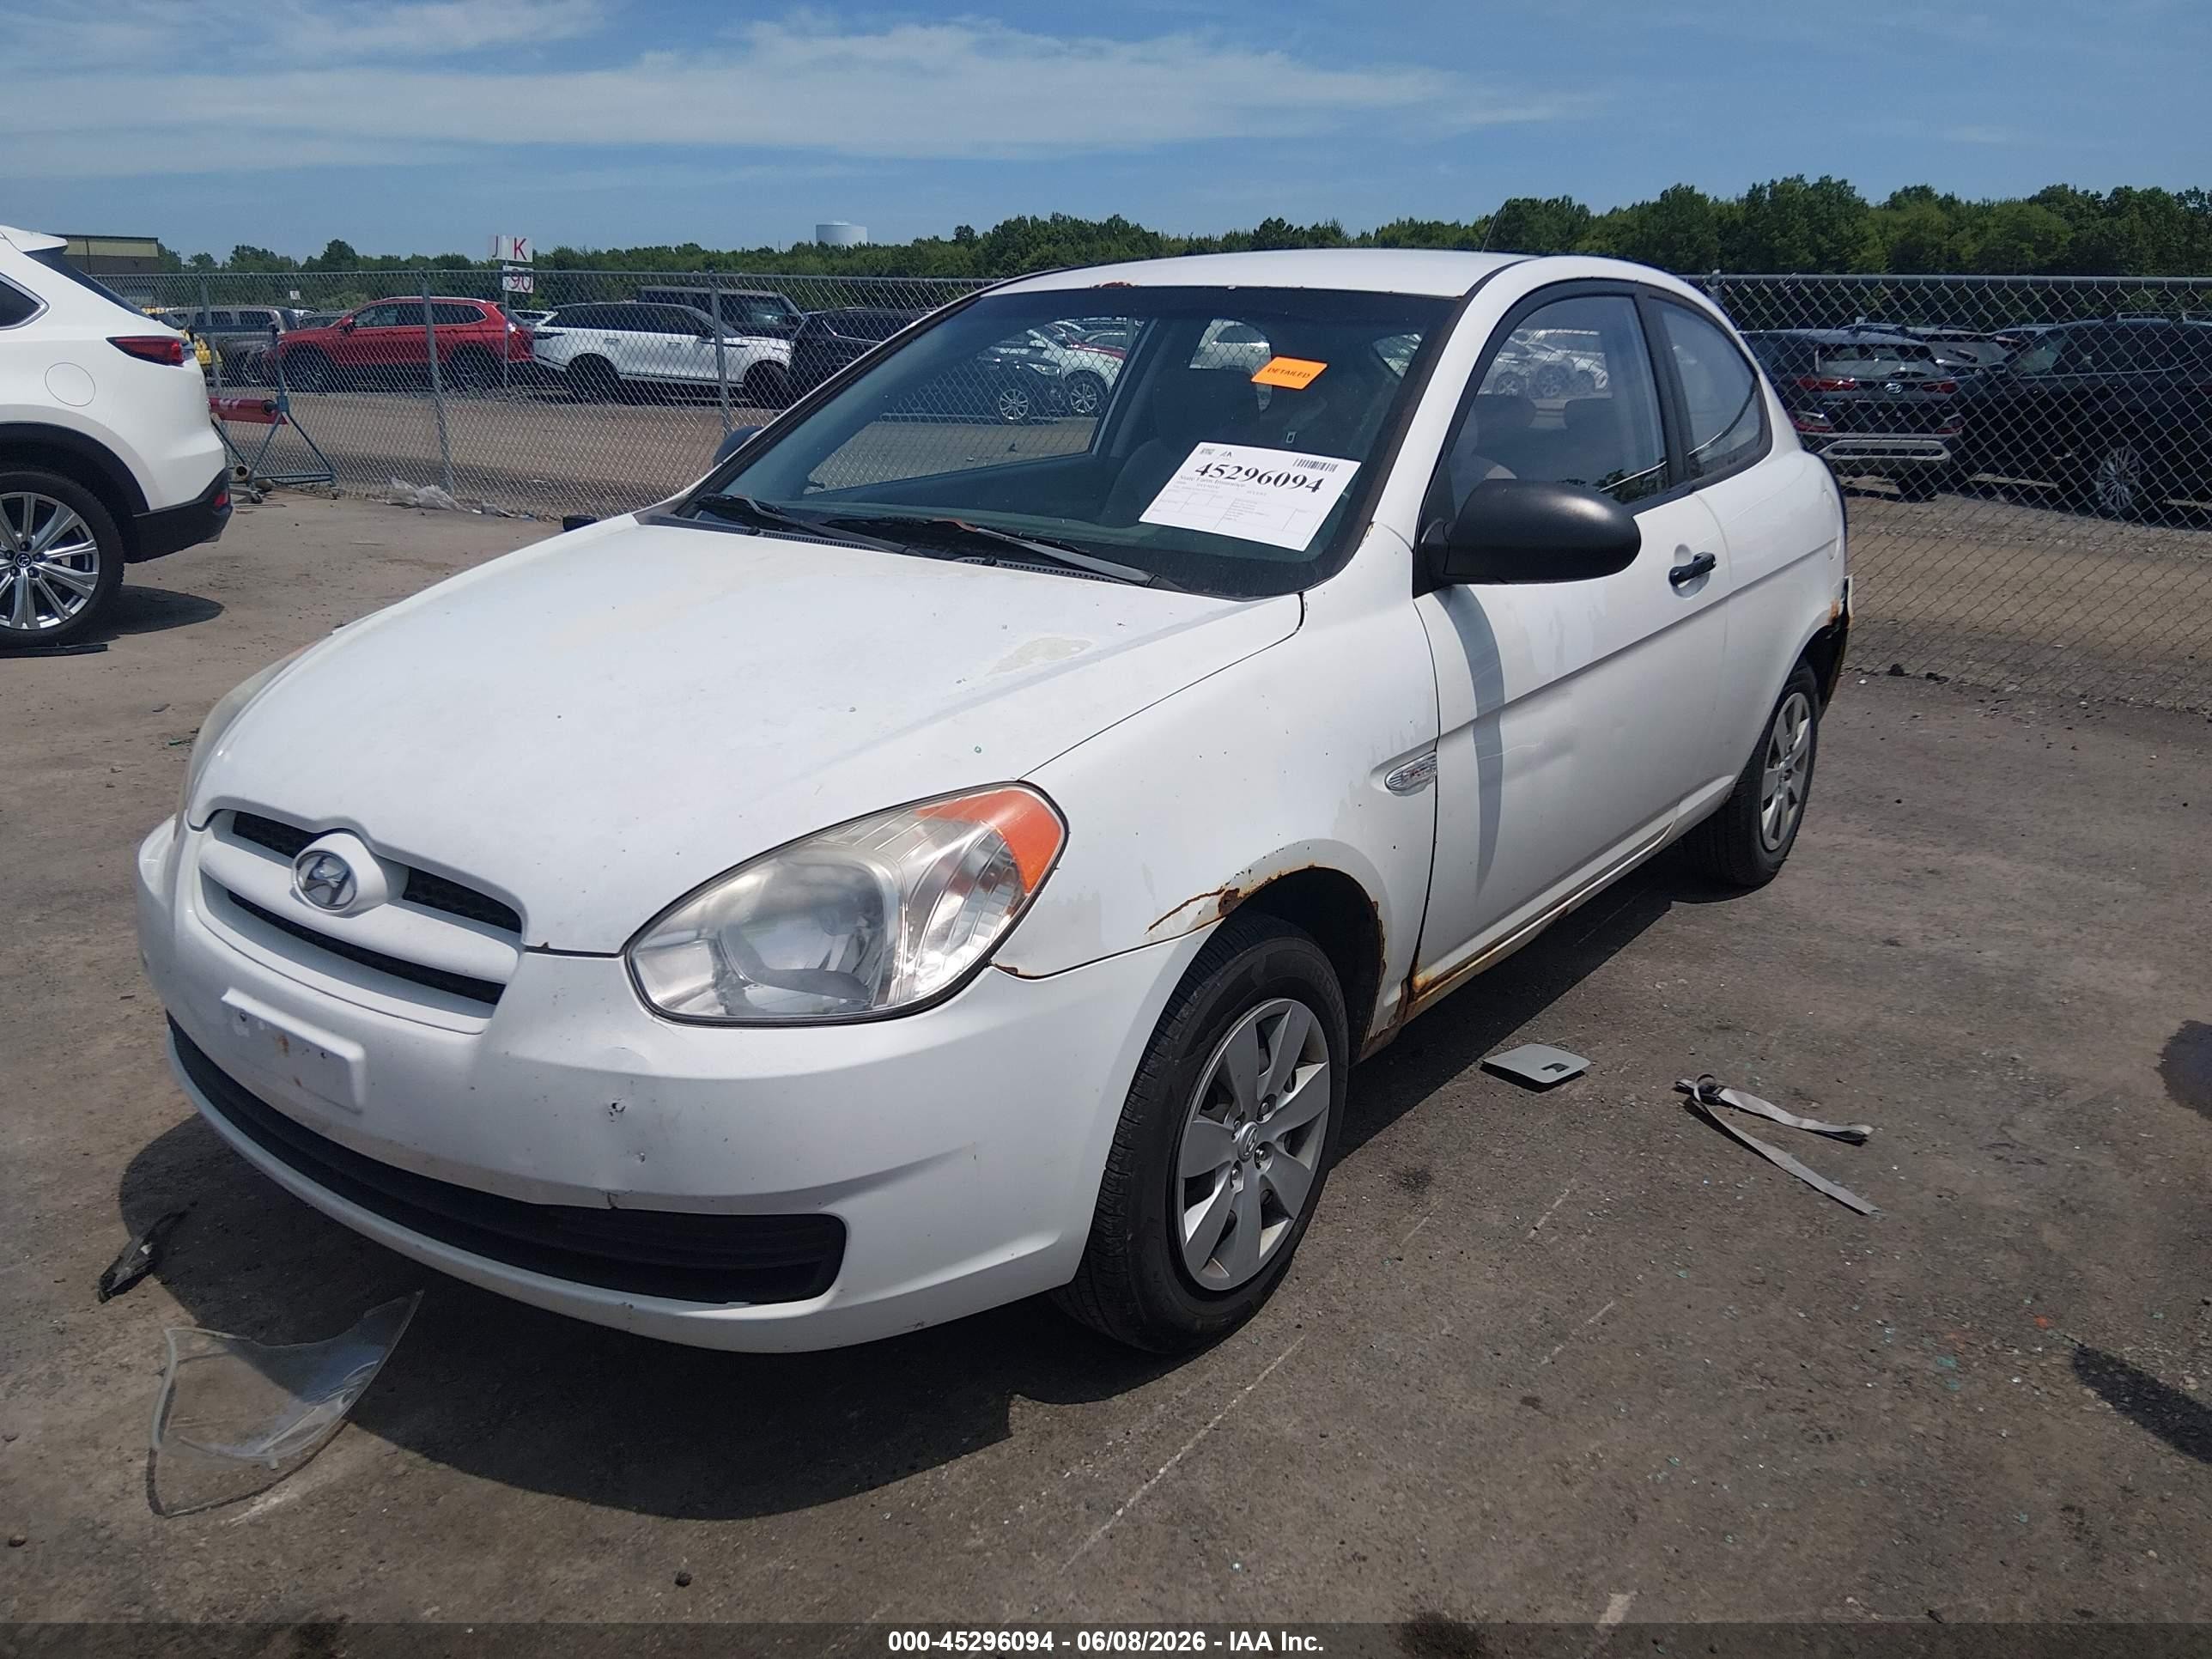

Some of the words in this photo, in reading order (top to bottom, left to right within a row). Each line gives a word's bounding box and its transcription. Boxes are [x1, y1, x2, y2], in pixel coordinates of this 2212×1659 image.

[514, 236, 527, 260] K
[509, 268, 532, 291] 90
[1267, 367, 1311, 379] DETAILED
[1194, 460, 1326, 494] 45296094
